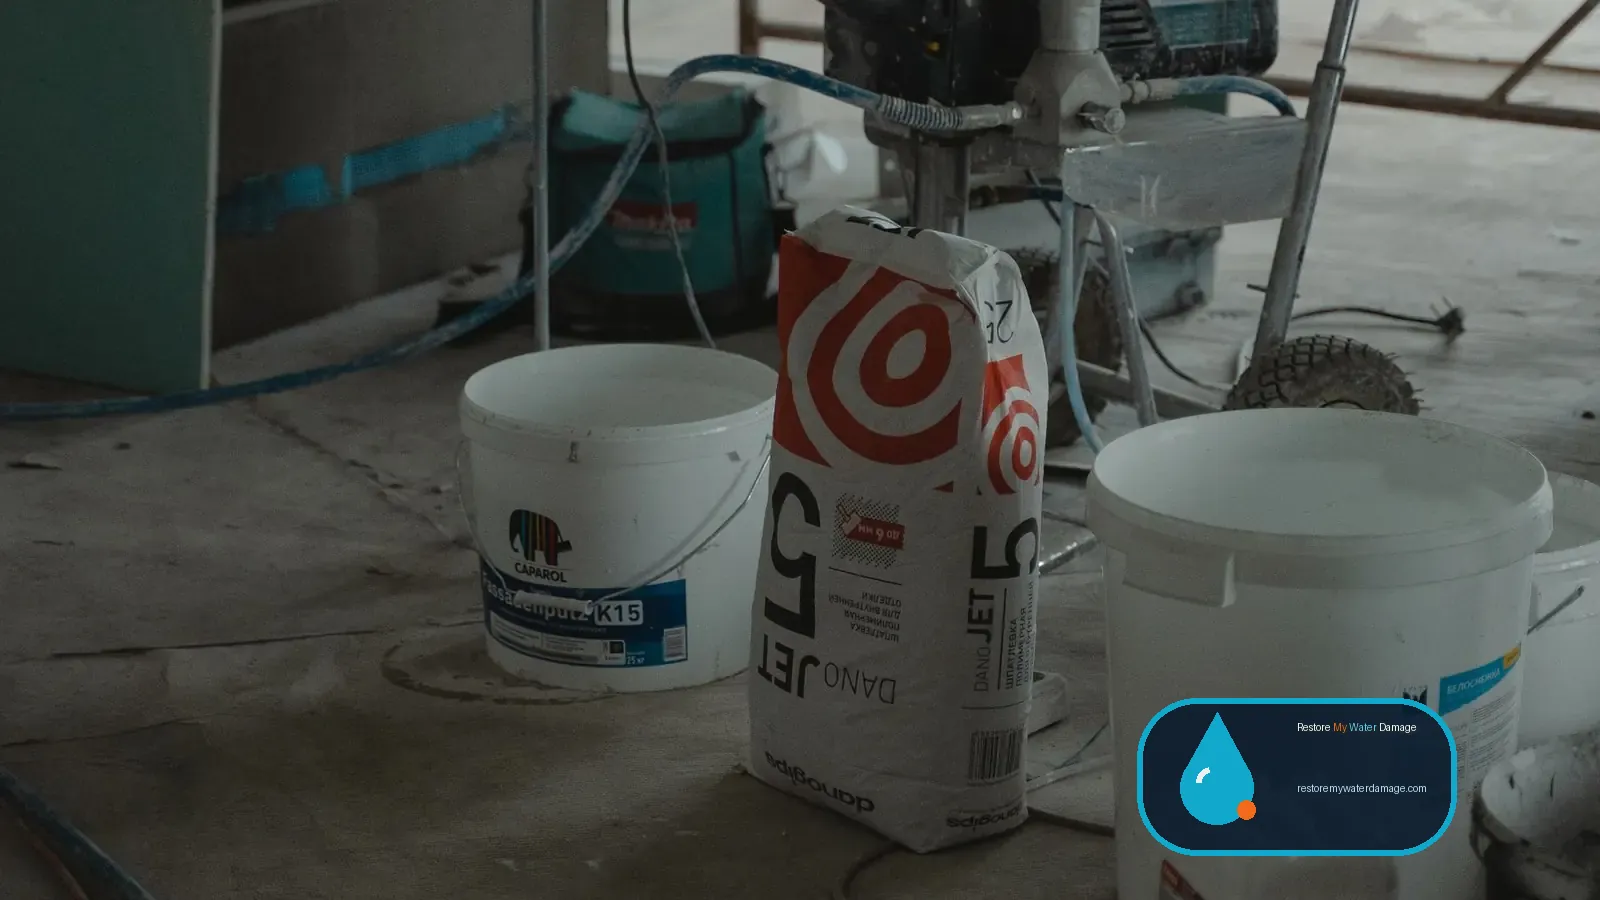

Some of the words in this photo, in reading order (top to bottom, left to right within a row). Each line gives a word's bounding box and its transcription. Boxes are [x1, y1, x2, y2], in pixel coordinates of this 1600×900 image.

[875, 525, 883, 541] 6
[971, 517, 1038, 579] 5
[514, 562, 567, 583] CAPAROL
[764, 471, 821, 640] 5
[597, 603, 641, 623] K15
[843, 609, 900, 631] ПОЛИМЕРНАЯ
[849, 622, 900, 644] ШПАТЛЕВКА
[1004, 617, 1018, 691] ШПАТЛЕВКА
[1015, 606, 1027, 687] ПОЛИМЕРНАЯ
[764, 751, 875, 814] danogips
